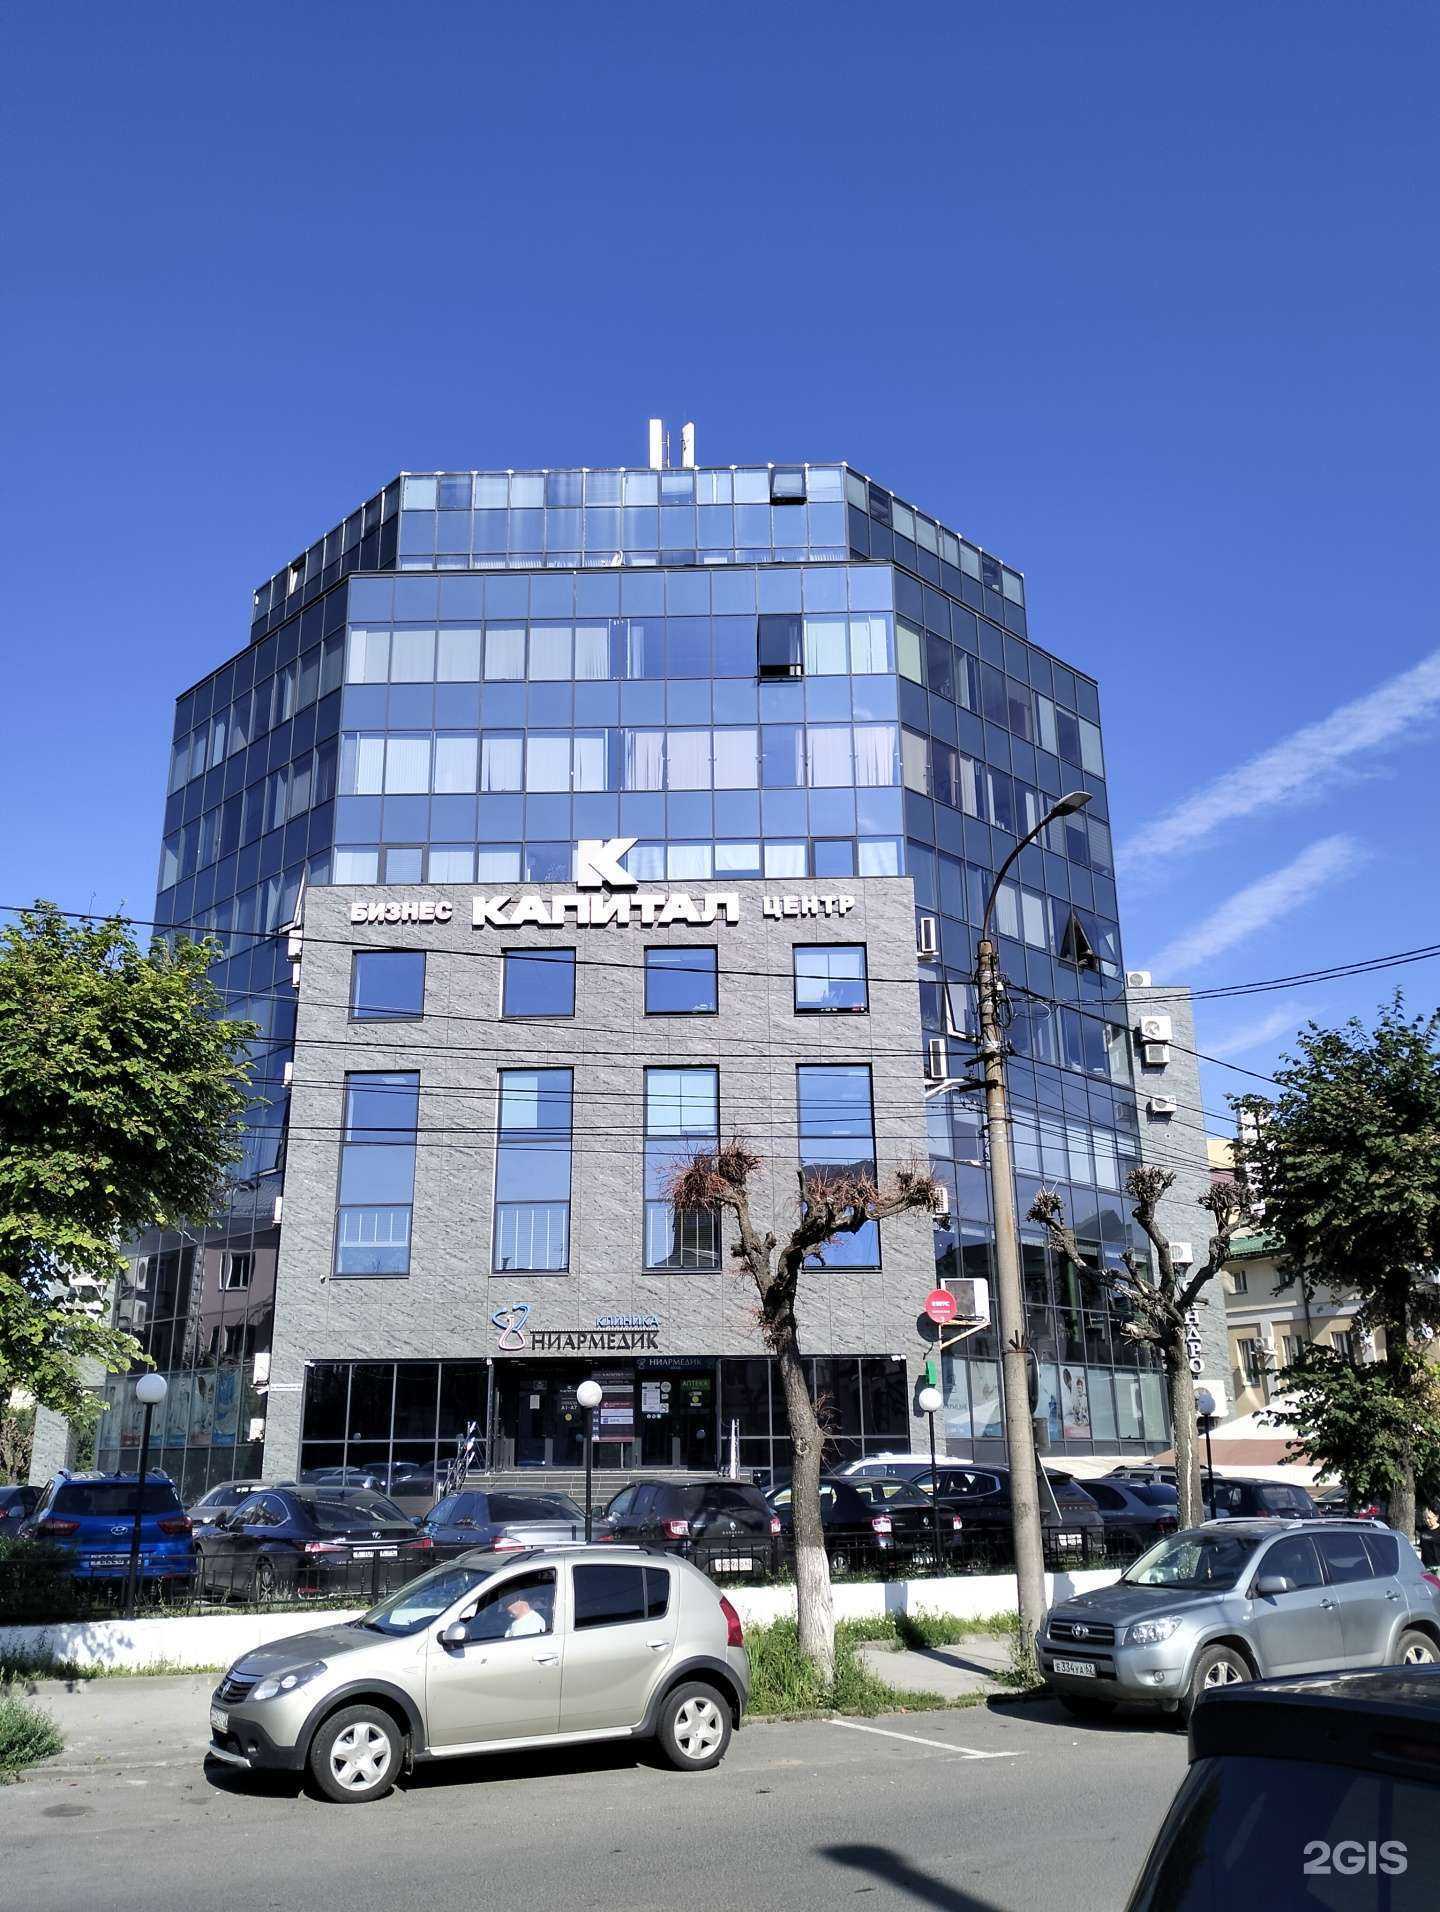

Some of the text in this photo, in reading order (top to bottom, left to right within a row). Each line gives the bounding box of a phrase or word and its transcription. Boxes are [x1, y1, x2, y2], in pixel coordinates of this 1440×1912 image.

[577, 838, 639, 890] К
[350, 893, 856, 927] БИЗНЕС КАПИТАЛ ЦЕНТР
[596, 1314, 660, 1328] КЛИНИКА
[531, 1332, 660, 1351] НИАРМЕДИК
